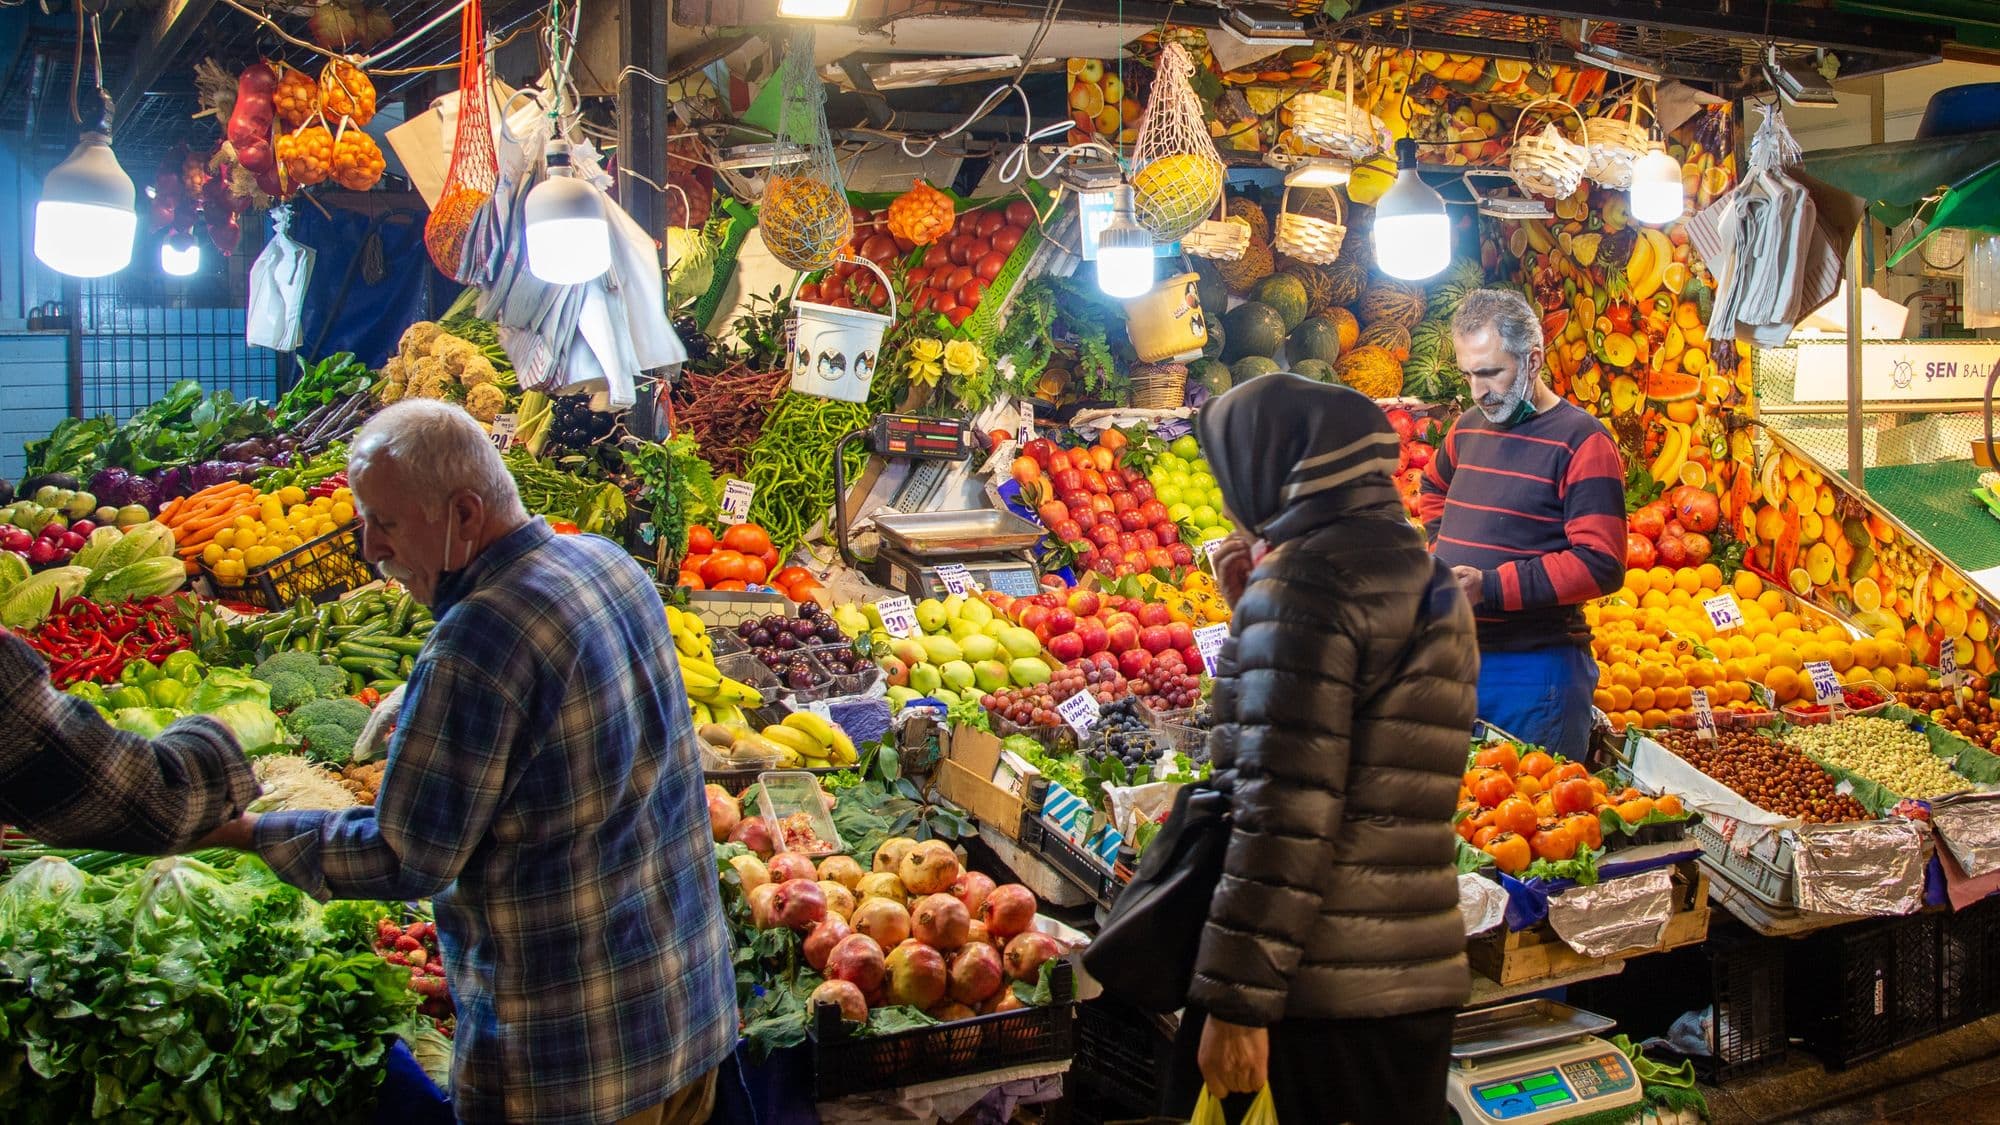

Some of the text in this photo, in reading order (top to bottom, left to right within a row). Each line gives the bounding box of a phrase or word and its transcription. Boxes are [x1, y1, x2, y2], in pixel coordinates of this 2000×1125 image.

[1925, 362, 1996, 382] ŞEN BALI
[947, 580, 965, 595] 15
[884, 615, 909, 632] 20
[1711, 609, 1732, 627] 15
[1060, 695, 1085, 715] KARA
